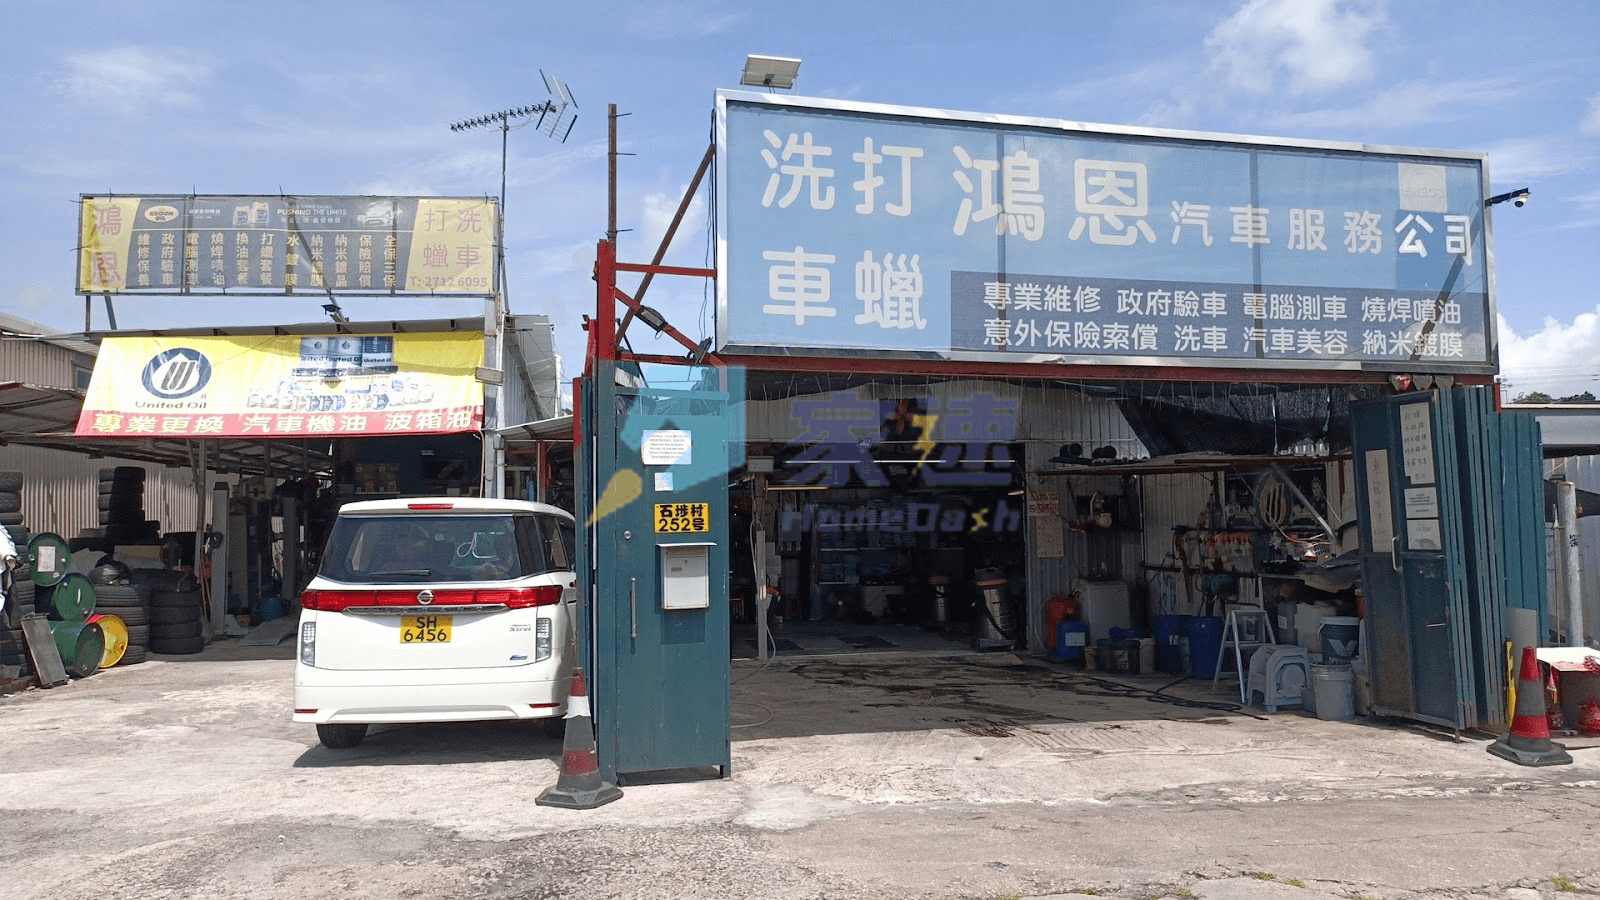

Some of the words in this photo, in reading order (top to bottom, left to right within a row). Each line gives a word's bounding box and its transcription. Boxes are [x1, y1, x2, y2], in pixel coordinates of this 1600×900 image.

[277, 208, 311, 216] PUSHING
[313, 208, 325, 216] THE
[326, 208, 347, 216] LIMITS
[953, 145, 1157, 246] 鴻恩
[1170, 200, 1474, 267] 汽車服務公司
[456, 209, 482, 269] 洗車
[760, 129, 837, 326] 洗車
[161, 233, 175, 286] 政府驗車
[425, 277, 455, 287] 2712
[457, 277, 488, 288] 6095
[983, 281, 1101, 314] 專業維修
[1116, 287, 1228, 319] 政府驗車
[1243, 292, 1348, 322] 電腦測車
[1361, 296, 1462, 325] 燒焊噴油
[983, 318, 1158, 351] 意外保險索償
[1174, 324, 1228, 353] 洗車
[1243, 326, 1348, 354] 汽車美容
[1362, 329, 1464, 358] 納米鍍膜
[92, 412, 225, 434] 專業更換
[241, 413, 368, 434] 汽車機油
[384, 407, 473, 431] 波箱油
[135, 401, 184, 409] United
[187, 401, 207, 409] Oil
[403, 628, 447, 642] 6456
[415, 615, 437, 629] SH
